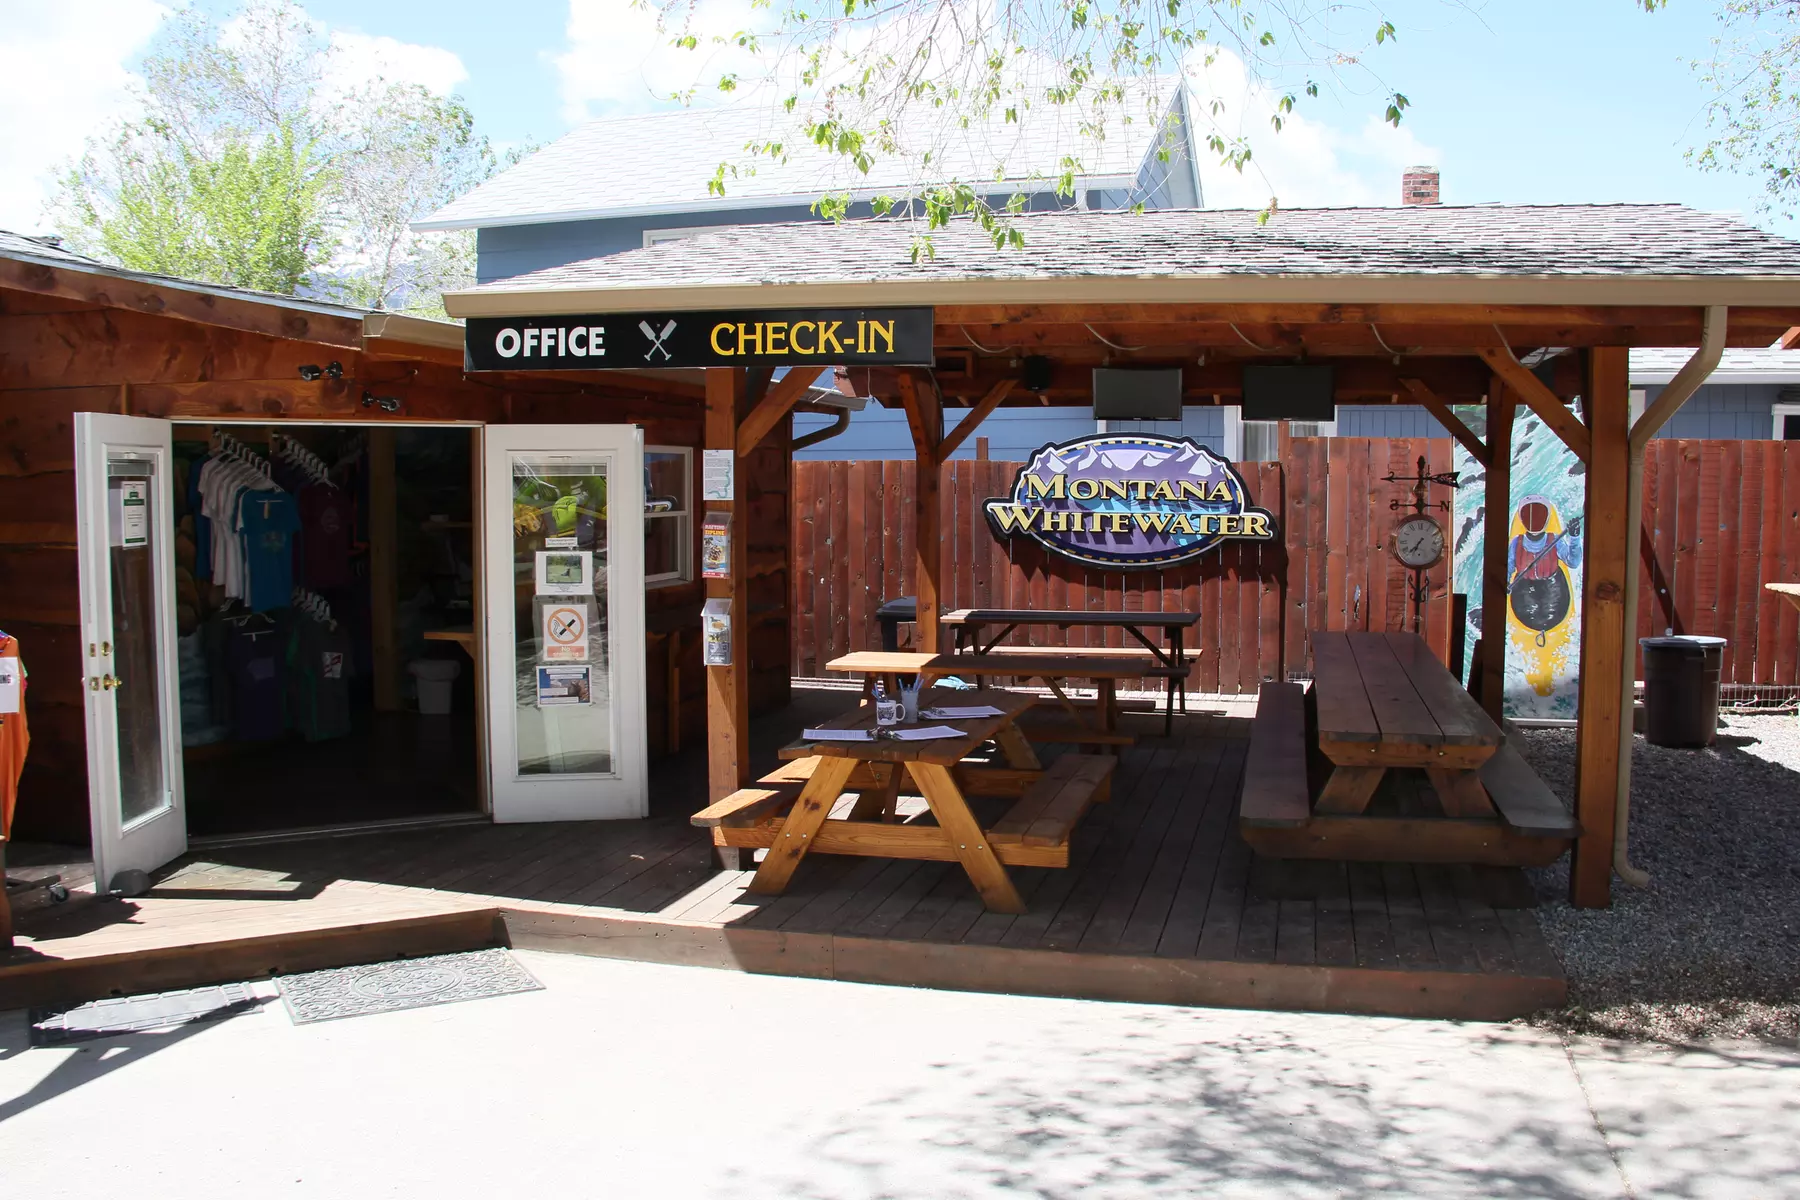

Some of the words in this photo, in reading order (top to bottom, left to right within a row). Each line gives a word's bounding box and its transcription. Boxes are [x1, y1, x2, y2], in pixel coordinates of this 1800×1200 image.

[495, 326, 606, 358] OFFICE
[710, 319, 895, 356] CHECK-IN
[1025, 473, 1234, 501] MONTANA
[990, 505, 1270, 537] WHITEWATER
